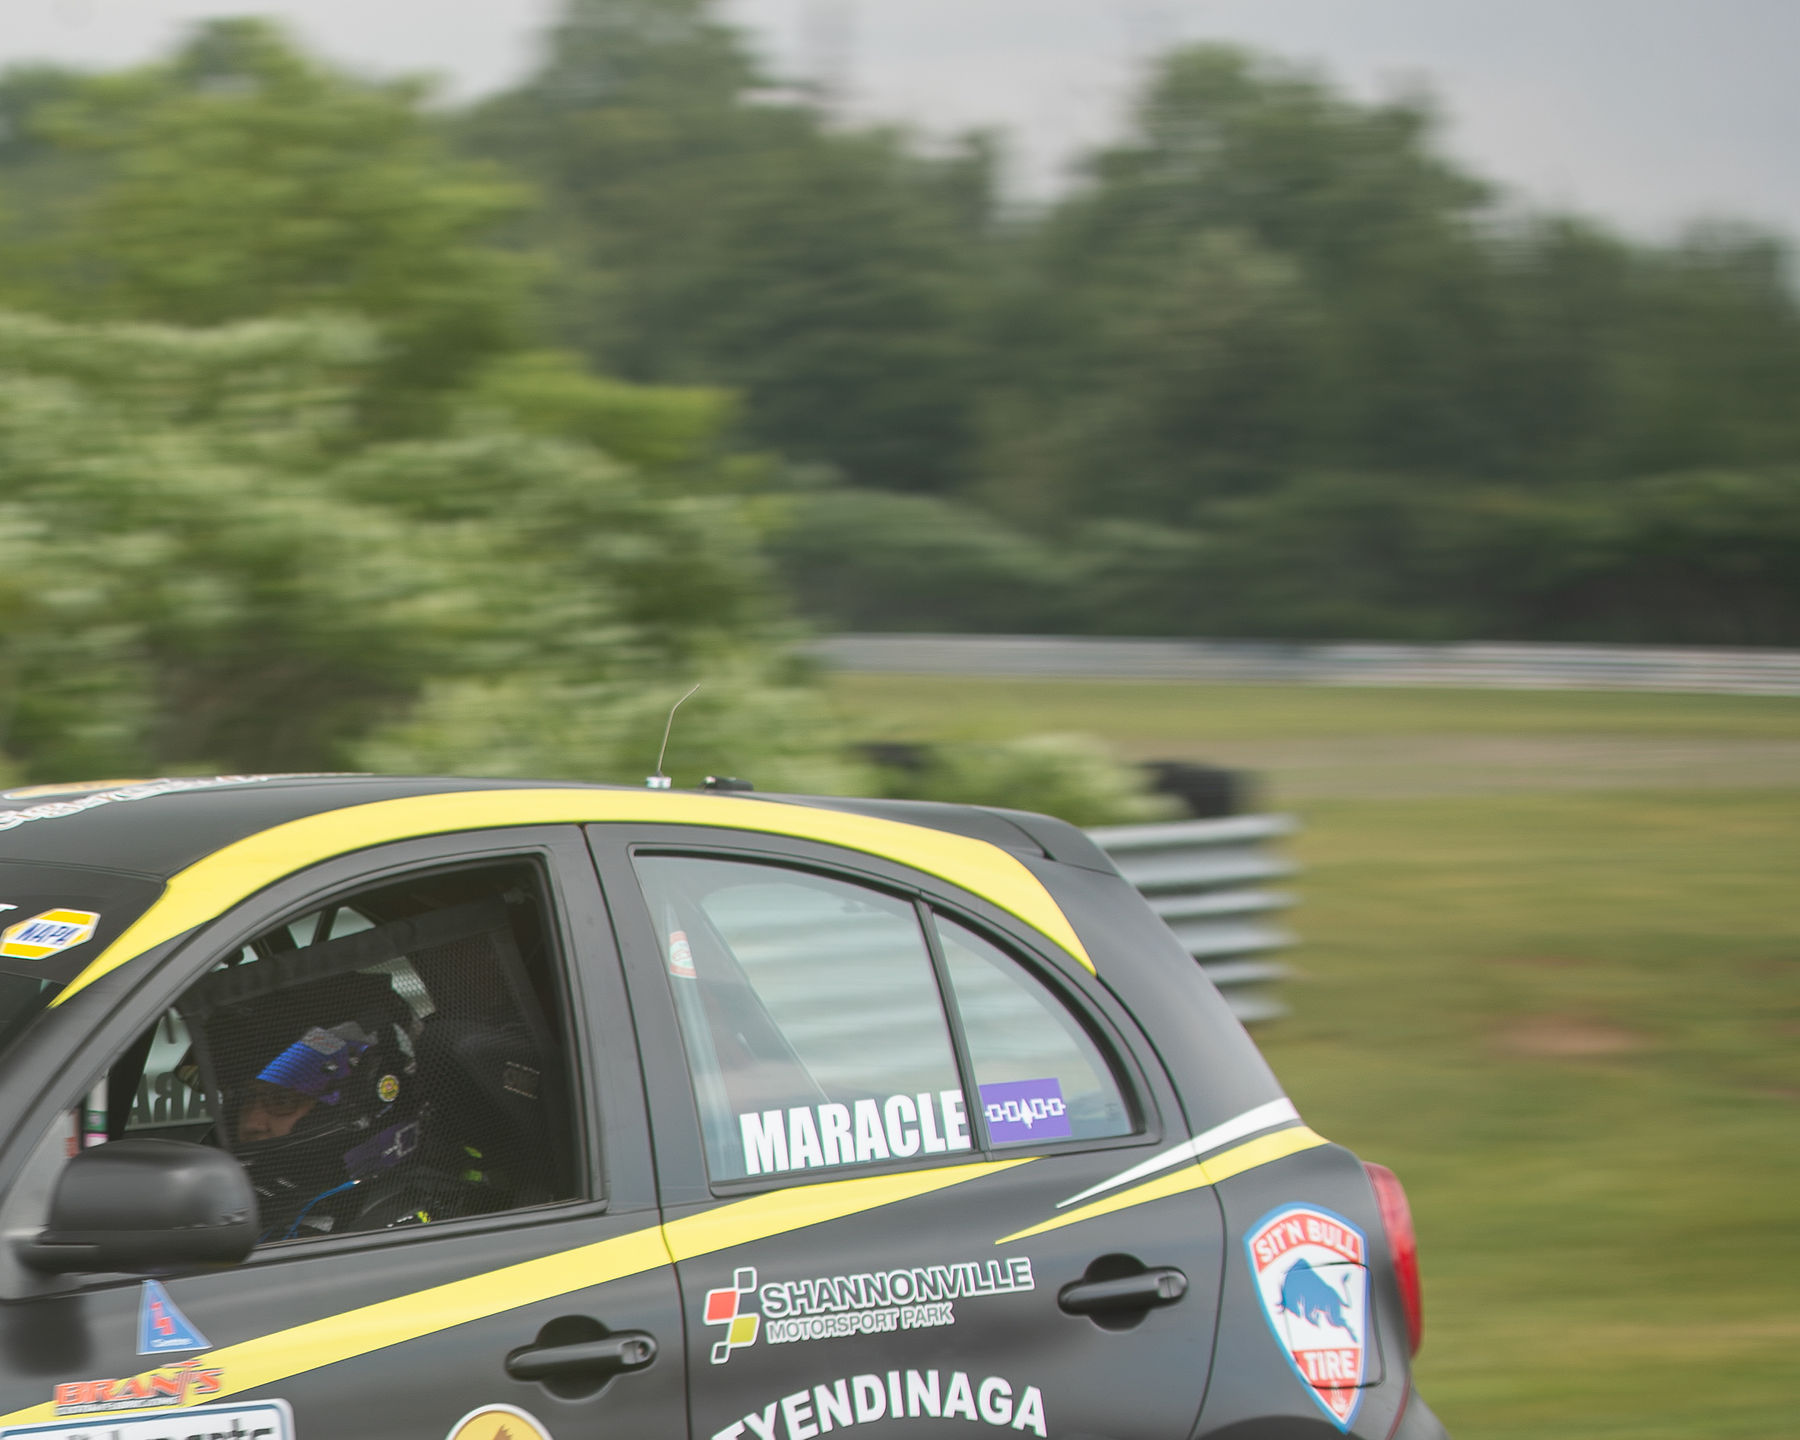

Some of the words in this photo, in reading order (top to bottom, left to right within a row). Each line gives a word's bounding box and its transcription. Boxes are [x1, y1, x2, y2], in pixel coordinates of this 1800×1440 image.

[739, 1089, 971, 1175] MARACLE
[1305, 1217, 1358, 1262] BULL
[760, 1257, 1034, 1318] SHANNONVILLE
[765, 1307, 899, 1344] MOTORSPORT
[901, 1301, 955, 1330] PARK
[1303, 1350, 1357, 1381] TIRE
